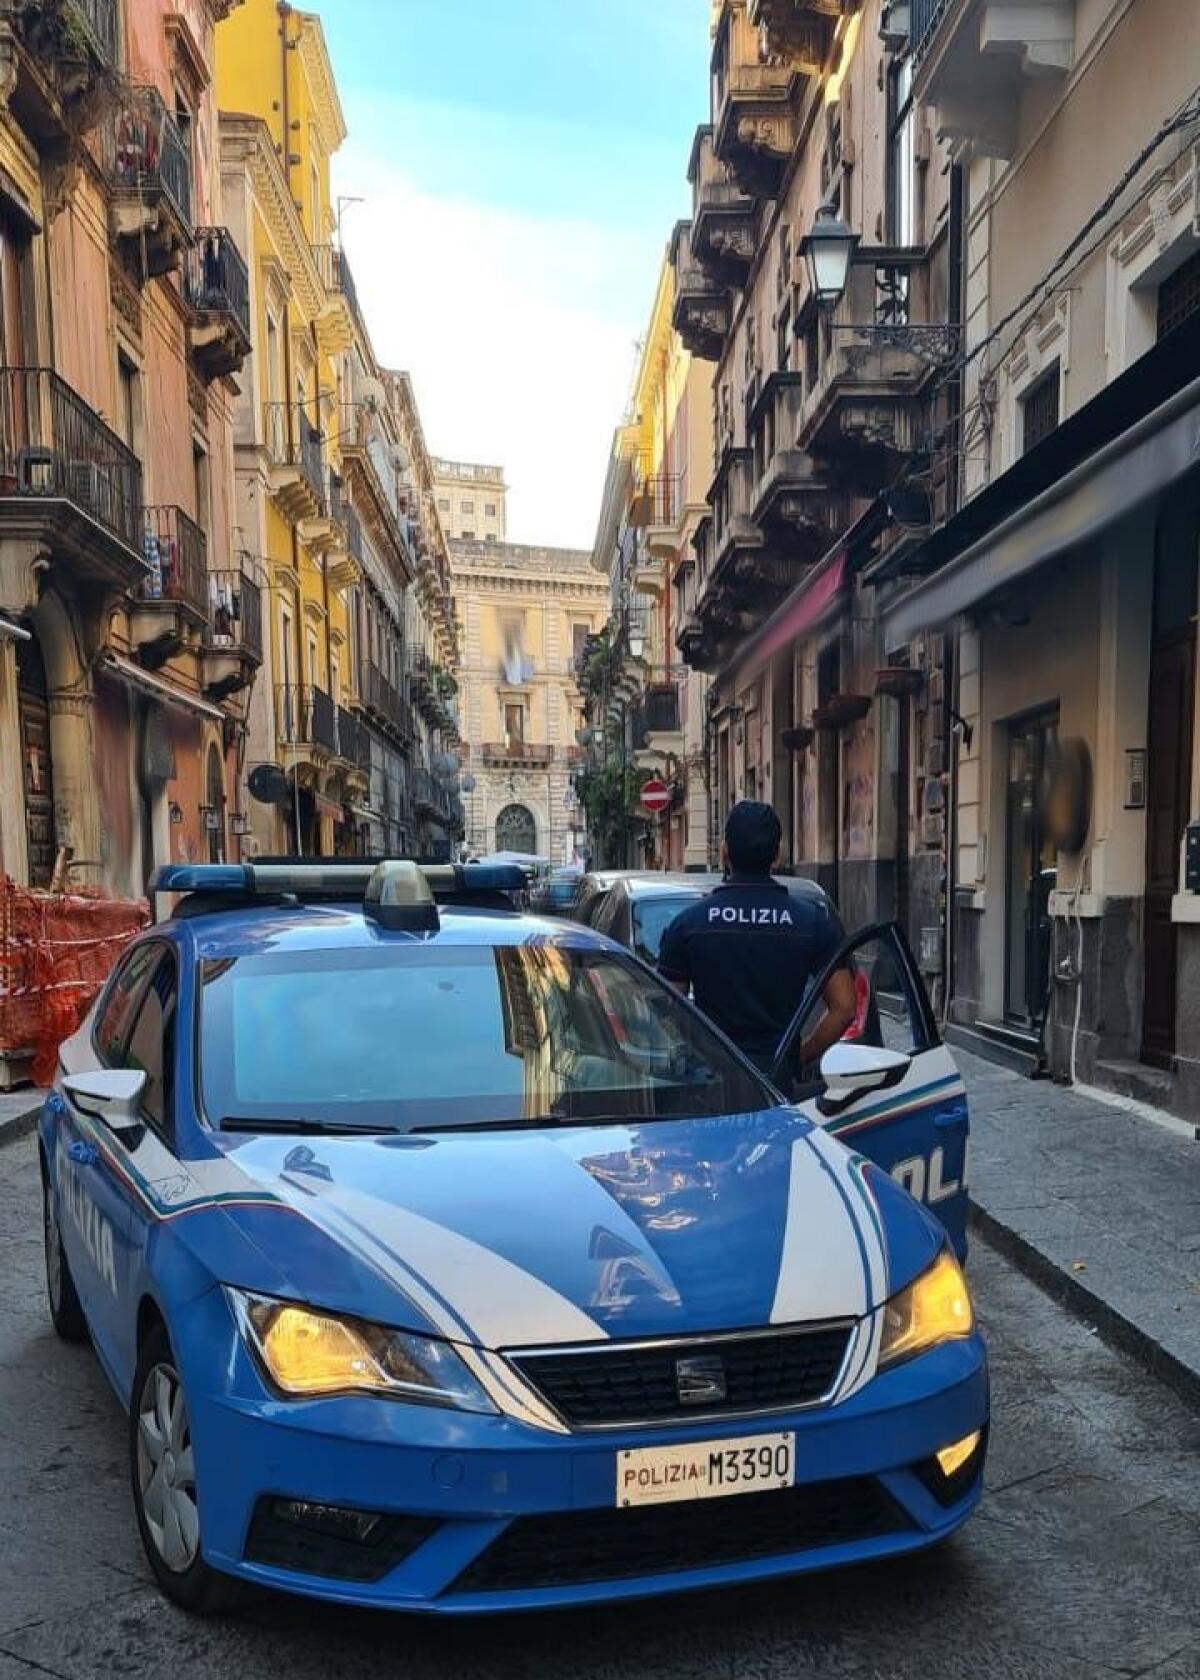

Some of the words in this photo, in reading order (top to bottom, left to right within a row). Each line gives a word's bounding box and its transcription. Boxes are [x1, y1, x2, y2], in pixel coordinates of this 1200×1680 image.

[708, 907, 793, 925] POLIZIA
[624, 1463, 699, 1488] POLIZIA
[708, 1444, 789, 1486] M3390
